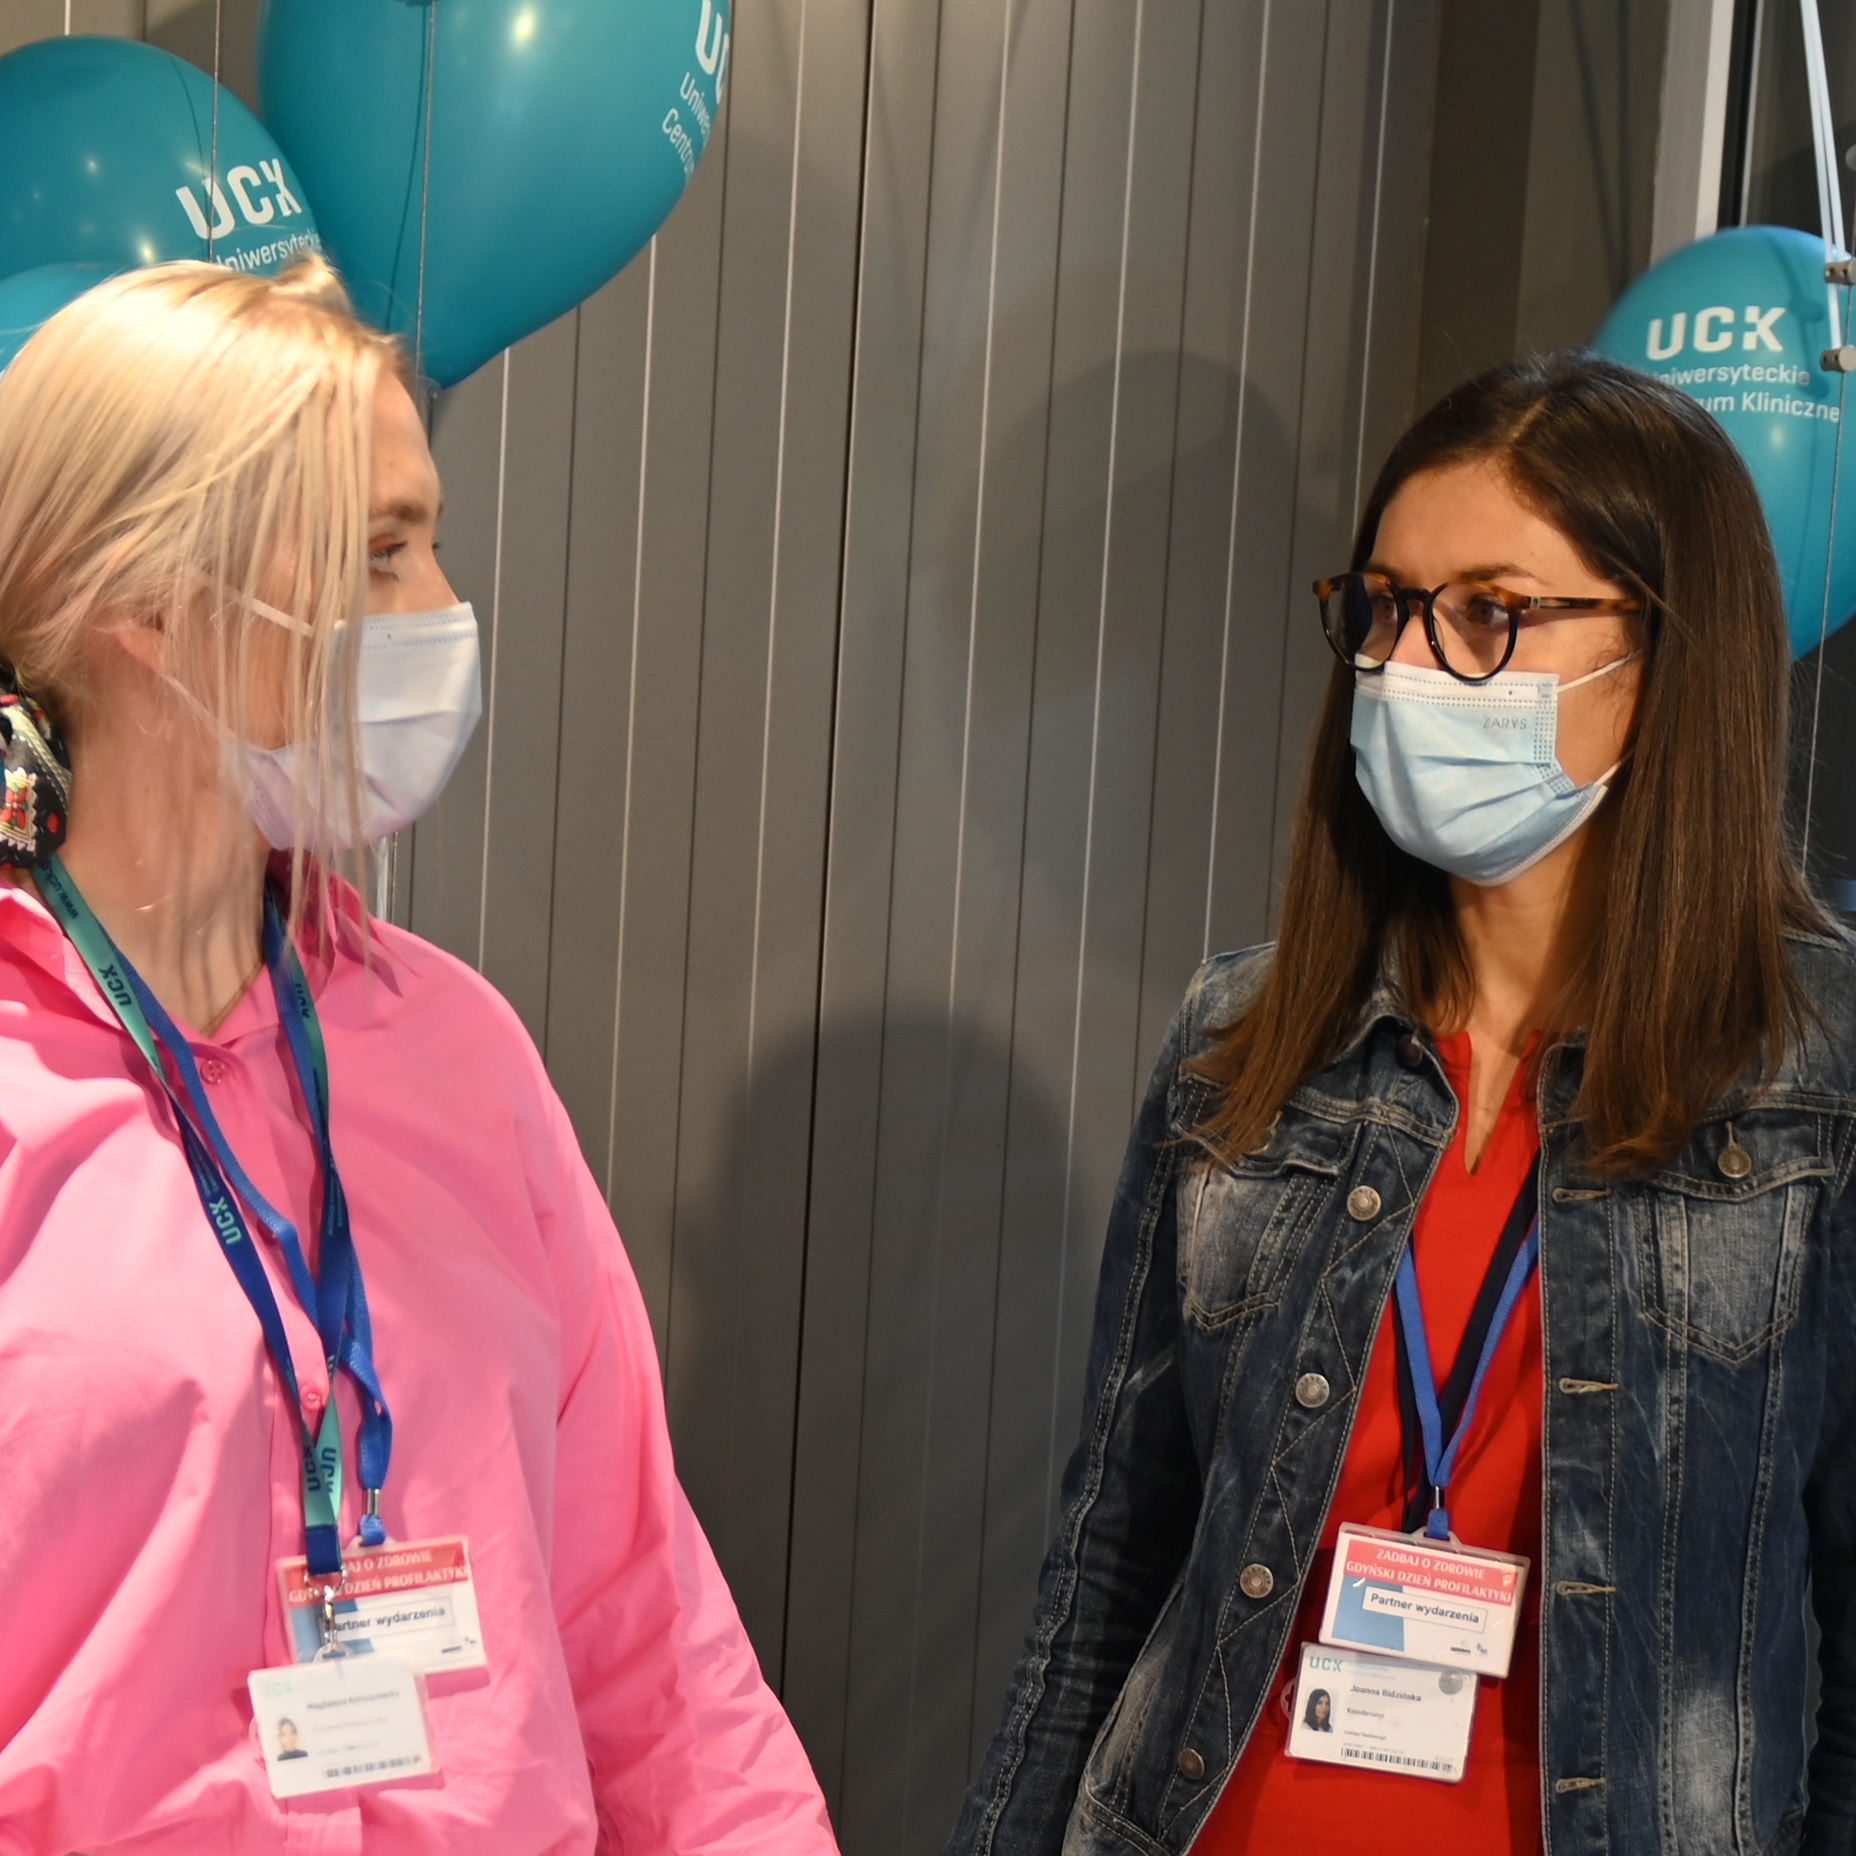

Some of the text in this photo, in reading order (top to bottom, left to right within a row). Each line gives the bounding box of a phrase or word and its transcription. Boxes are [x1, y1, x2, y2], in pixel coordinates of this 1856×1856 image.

[175, 158, 302, 240] UCK
[1647, 305, 1786, 361] UCK
[1742, 391, 1841, 422] Kliniczne
[209, 1196, 241, 1245] UCK
[376, 1549, 433, 1571] ZDROWIE
[1376, 1548, 1485, 1580] ZADBAJ O ZDROWIE
[1346, 1560, 1512, 1604] GDYŃSKI DZIEŃ PROFILAKTYKI
[376, 1605, 446, 1628] wydarzenia
[1371, 1592, 1479, 1623] Partner wydarzenia
[1309, 1655, 1343, 1673] UCK
